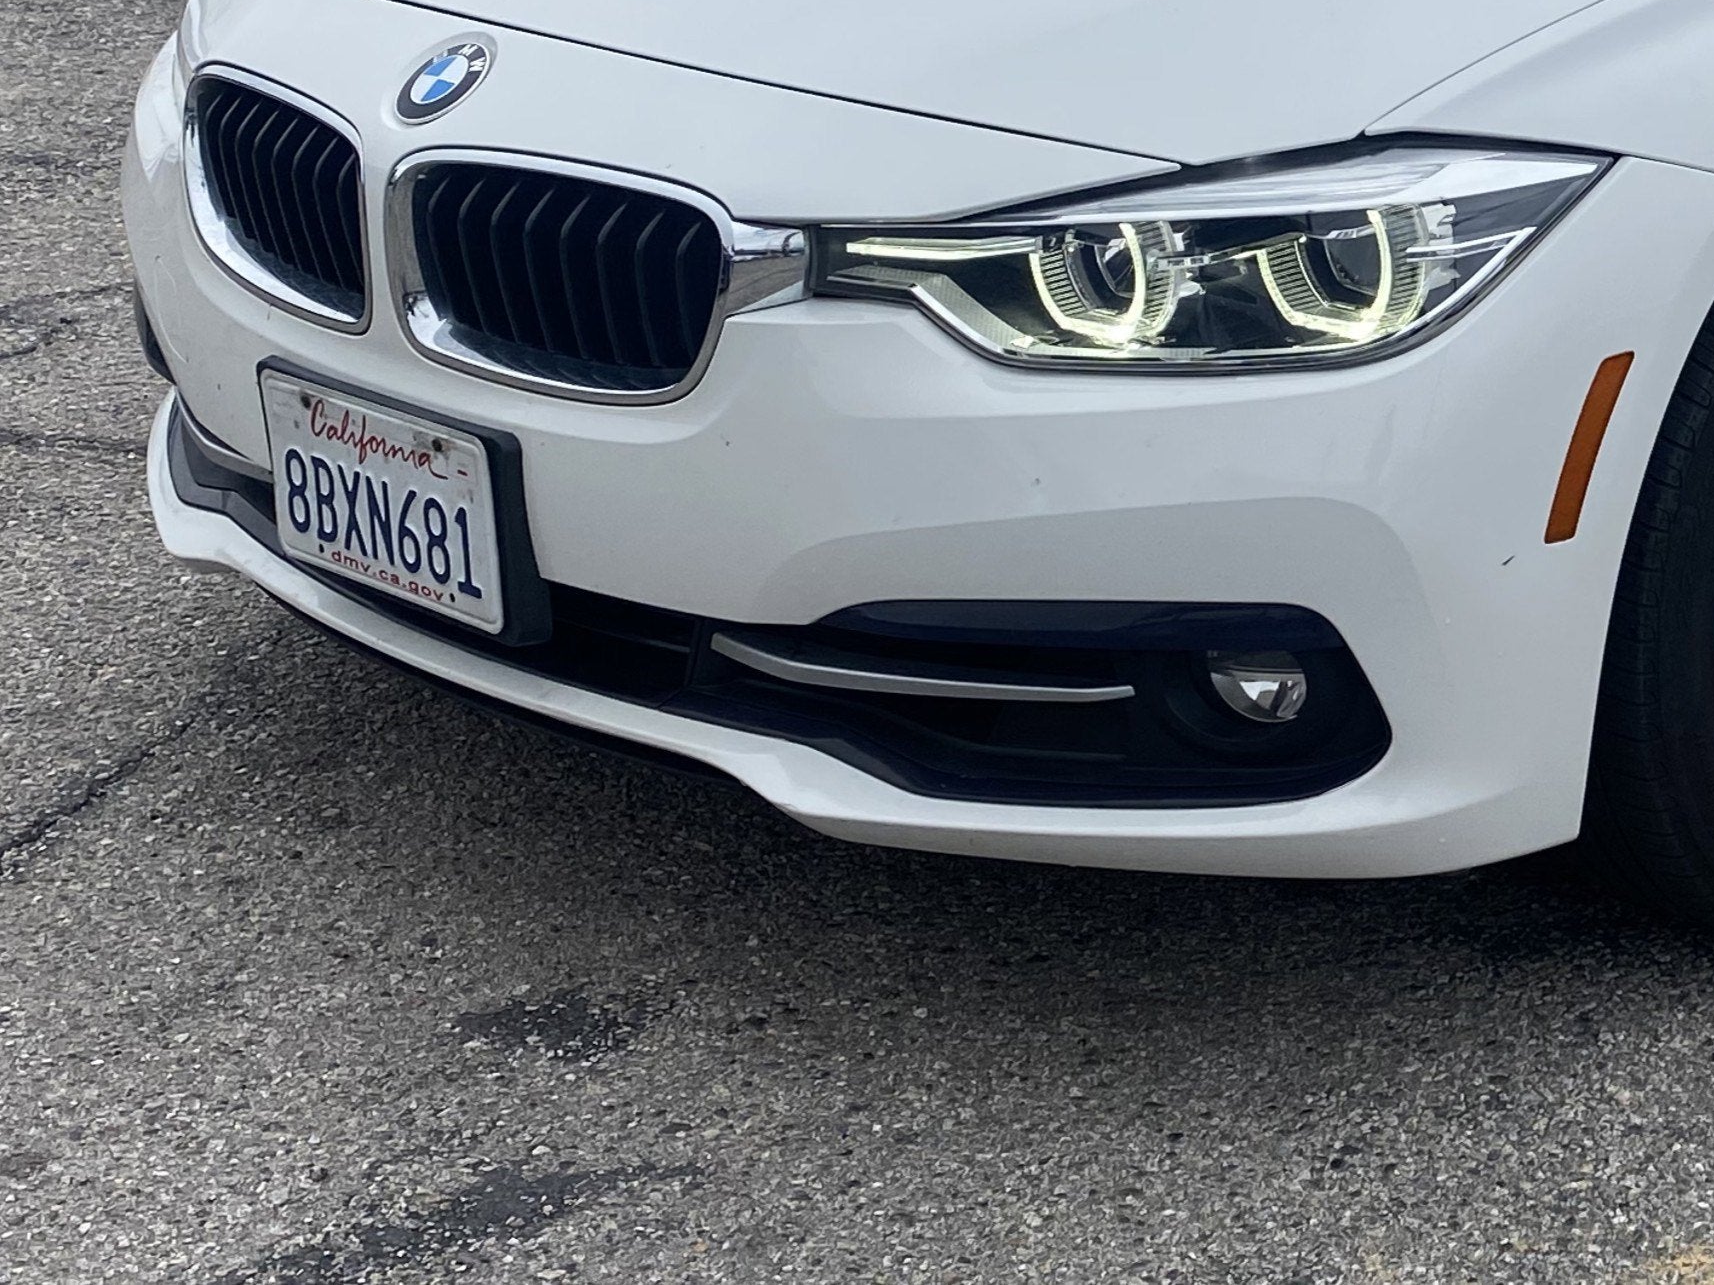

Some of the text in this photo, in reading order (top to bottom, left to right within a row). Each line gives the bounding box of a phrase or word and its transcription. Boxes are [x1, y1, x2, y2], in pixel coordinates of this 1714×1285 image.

[310, 398, 449, 481] California
[285, 447, 483, 600] 8BXN681
[331, 549, 445, 602] dmv.ca.gov
